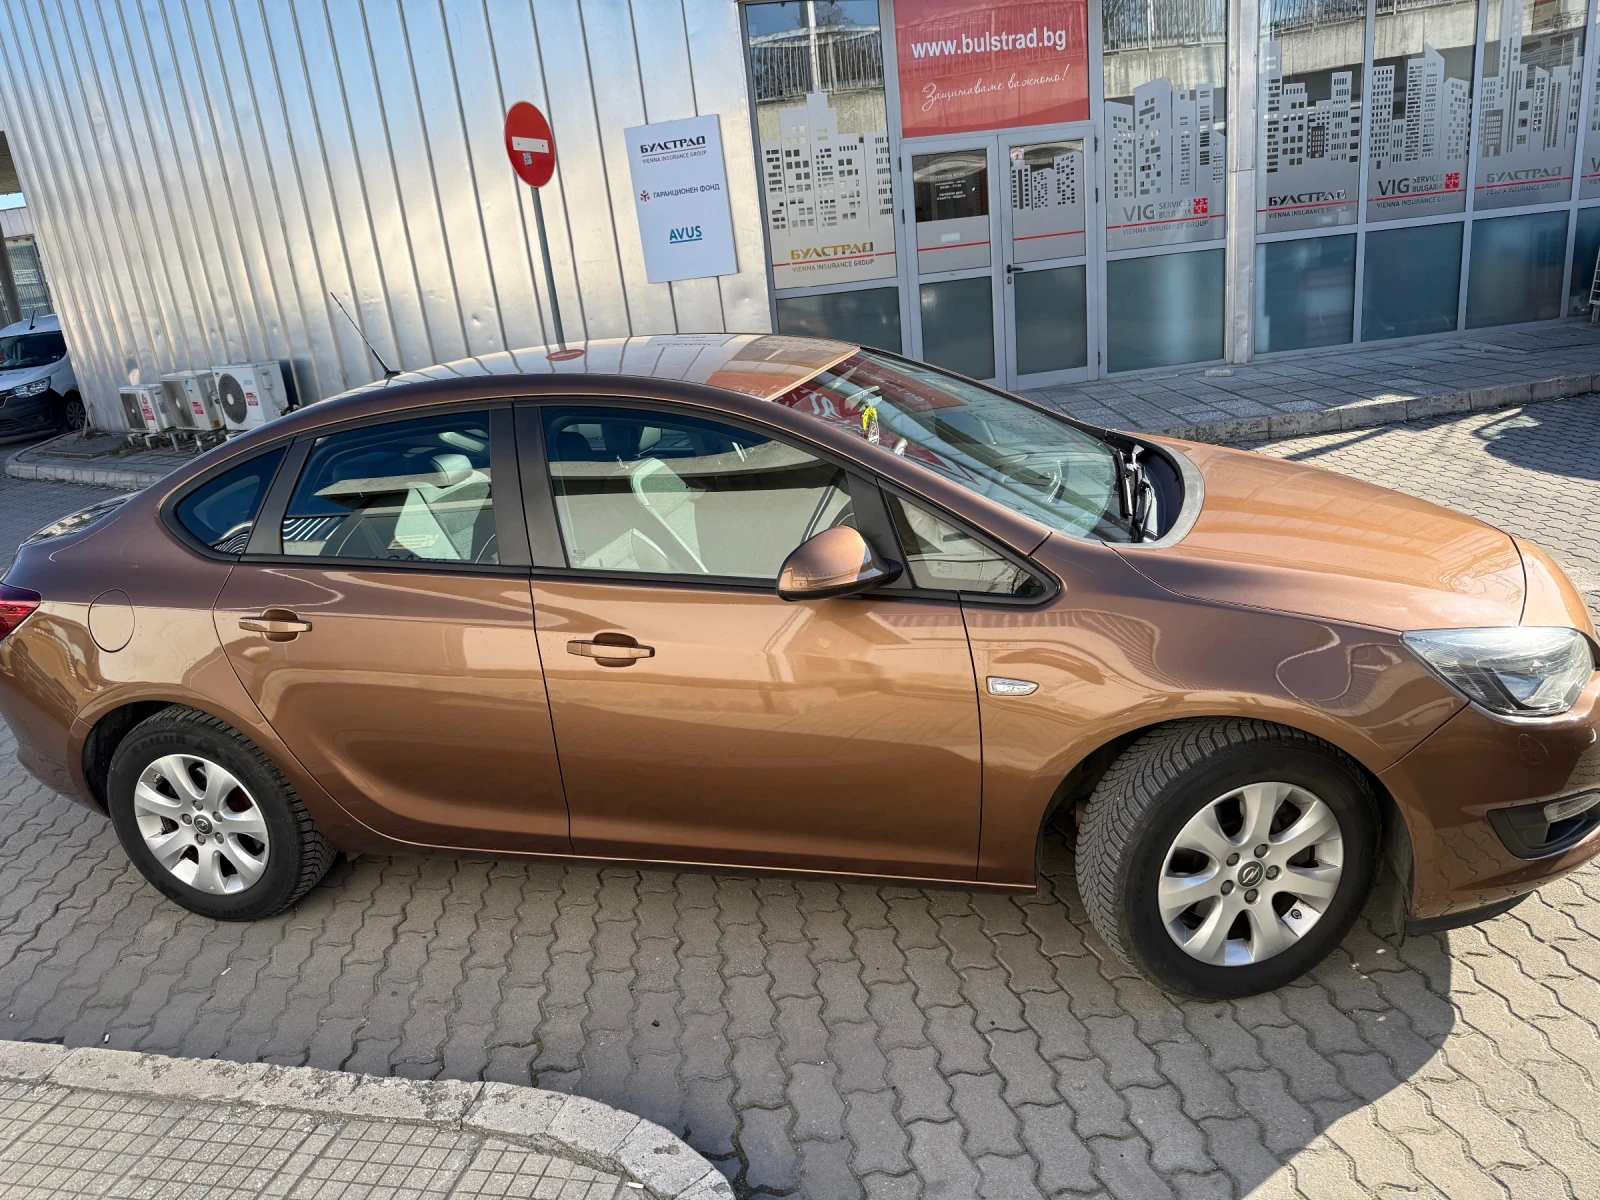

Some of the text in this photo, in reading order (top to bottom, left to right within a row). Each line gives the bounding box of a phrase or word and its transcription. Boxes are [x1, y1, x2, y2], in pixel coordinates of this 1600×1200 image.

[911, 27, 1067, 58] www.bulstrad.bg
[921, 64, 1070, 112] Защитаваме важното!
[640, 136, 706, 153] БУЛСТРАД
[662, 153, 689, 162] INSURANCE
[1412, 174, 1443, 184] SERVICES
[1486, 166, 1563, 183] БУЛСТРАД
[653, 184, 720, 198] ГАРАНЦИОНЕН ФОНД
[1378, 177, 1410, 196] VIG
[1412, 183, 1443, 192] BULGARIA
[1508, 184, 1541, 193] INSURANCE
[1541, 182, 1561, 190] GROUP
[1268, 189, 1346, 206] БУЛСТРАД
[1376, 201, 1400, 209] VIENNA
[1401, 196, 1436, 206] INSURANCE
[1122, 203, 1155, 222] VIG
[1268, 210, 1290, 219] VIENNA
[1291, 207, 1325, 217] INSURANCE
[669, 225, 702, 240] AVUS
[1123, 227, 1148, 236] VIENNA
[1186, 220, 1209, 229] GROUP
[790, 242, 874, 260] БУЛСТРАД
[792, 258, 875, 273] VIENNA INSURANCE GROUP
[131, 735, 186, 757] SAILUN
